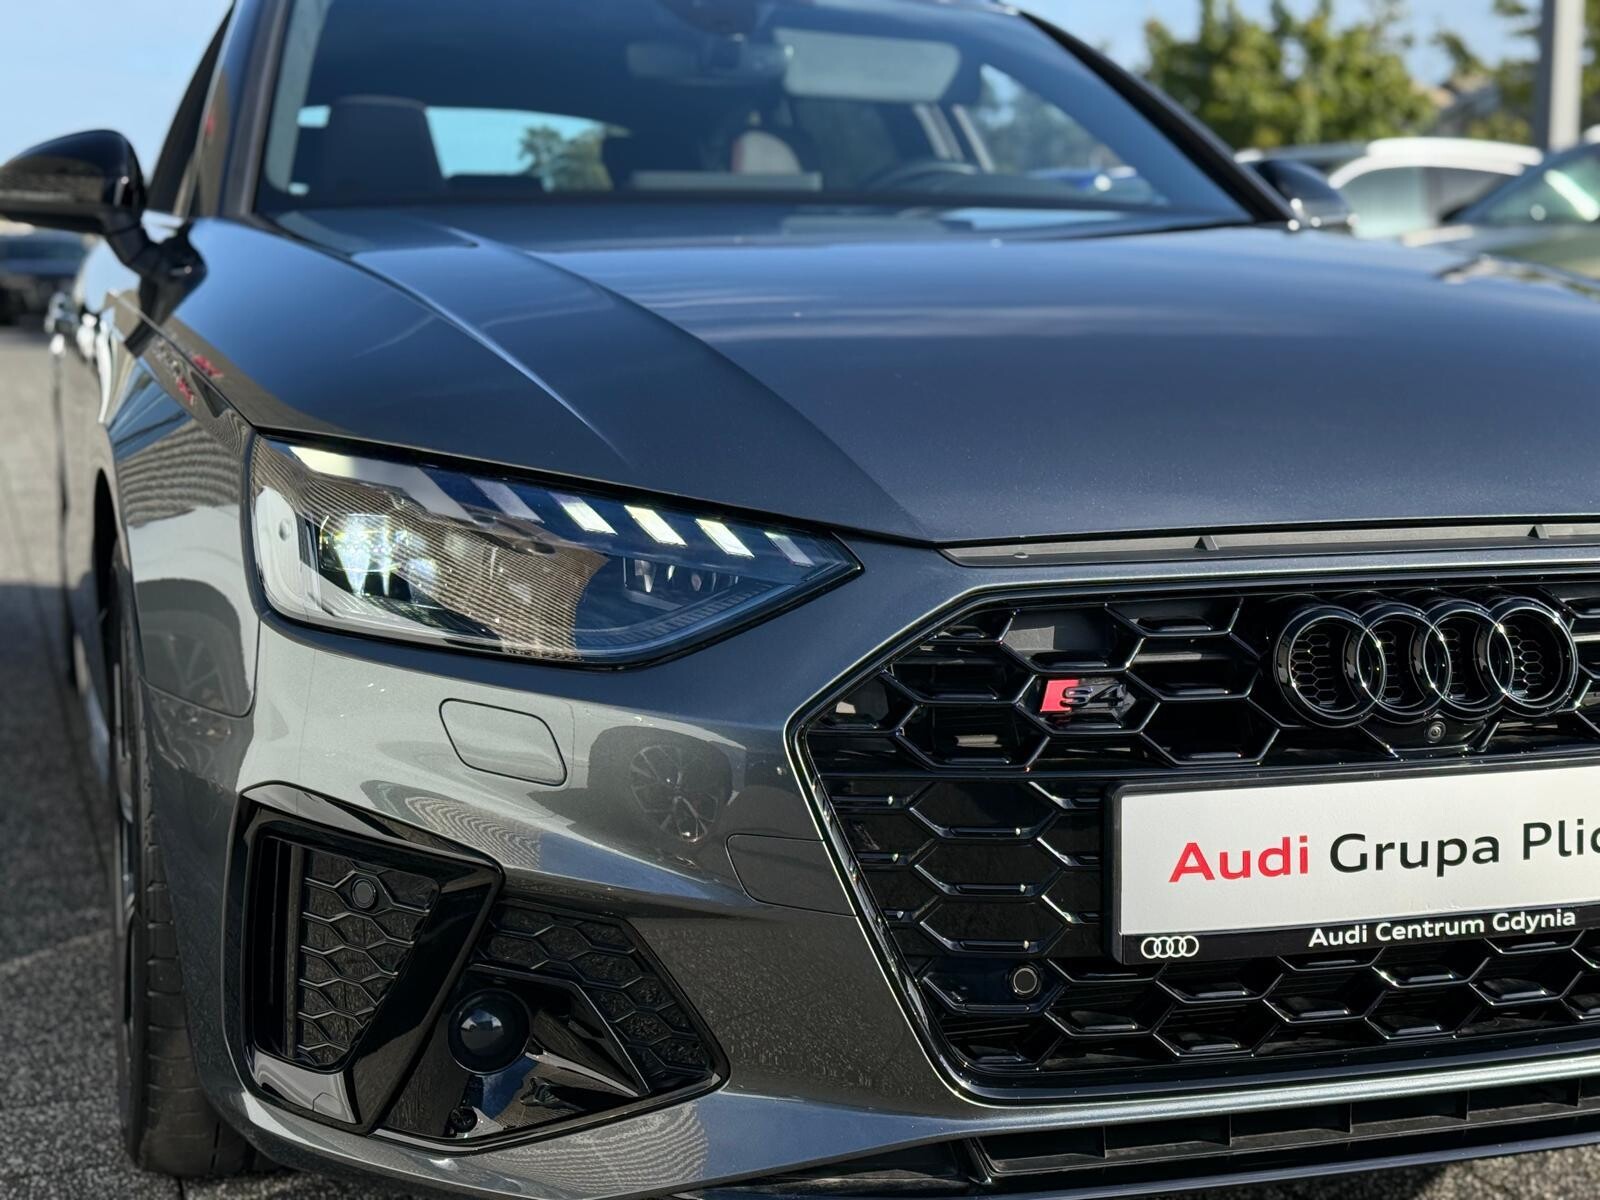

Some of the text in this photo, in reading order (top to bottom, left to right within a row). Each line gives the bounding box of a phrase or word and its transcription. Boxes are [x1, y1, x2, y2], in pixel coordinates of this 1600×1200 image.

[1057, 681, 1130, 710] S4
[1169, 835, 1309, 883] Audi
[1330, 833, 1500, 878] Grupa
[1308, 909, 1577, 948] Audi Centrum Gdynia
